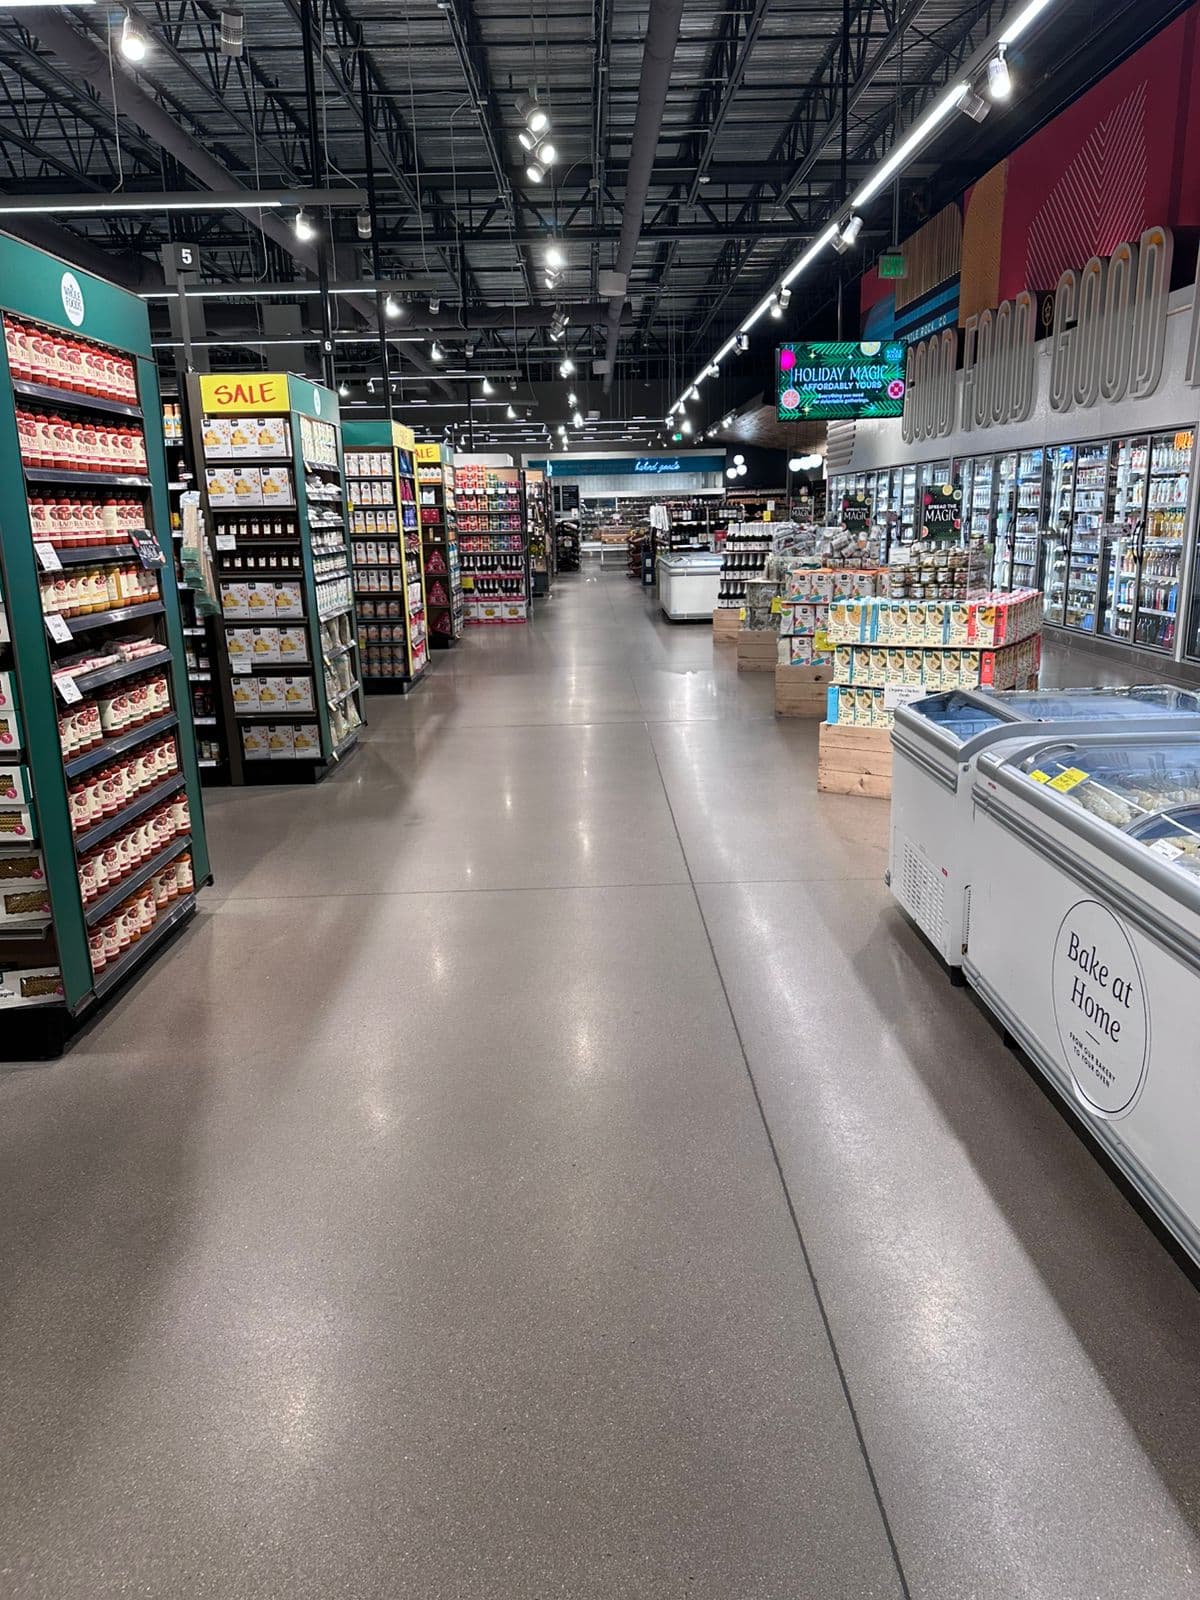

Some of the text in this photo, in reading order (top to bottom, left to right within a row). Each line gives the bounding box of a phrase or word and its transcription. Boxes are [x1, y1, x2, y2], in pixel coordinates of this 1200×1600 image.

[181, 248, 192, 264] 5
[961, 290, 1036, 431] FOOD
[1049, 226, 1174, 412] GOOD
[324, 341, 332, 351] 6
[794, 365, 888, 382] HOLIDAY MAGIC
[214, 381, 276, 405] SALE
[391, 384, 397, 392] 7
[801, 381, 882, 391] AFFORDABLY YOURS
[414, 445, 434, 460] ALE
[843, 511, 869, 521] MAGIC
[925, 508, 959, 522] MAGIC
[1067, 931, 1133, 1008] Bake at
[1070, 975, 1121, 1043] Home
[1069, 1031, 1116, 1082] FROM OUR BAKERY
[1073, 1045, 1110, 1088] TO YOUR OVEN
